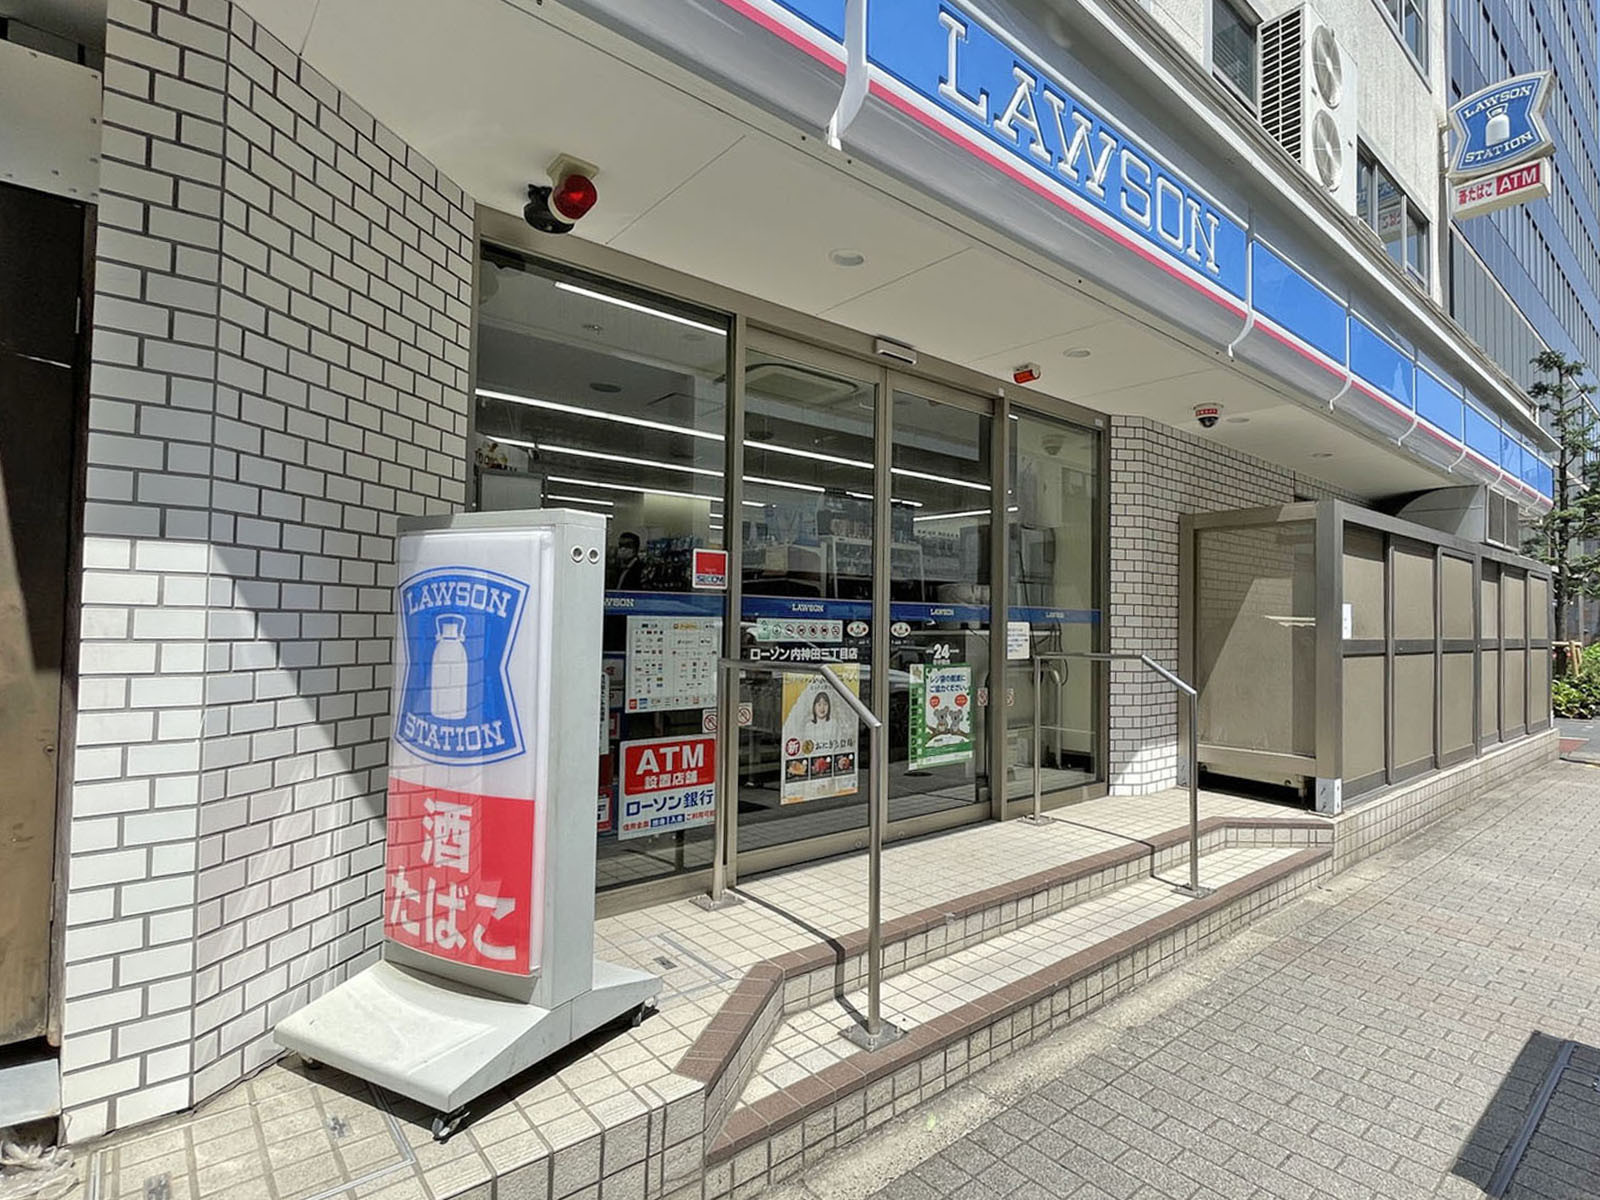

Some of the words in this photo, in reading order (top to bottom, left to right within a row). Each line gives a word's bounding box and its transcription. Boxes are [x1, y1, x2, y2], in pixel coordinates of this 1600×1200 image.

[1463, 85, 1532, 119] LAWSON
[938, 11, 1220, 275] LAWSON
[1465, 131, 1534, 163] STATION
[1500, 167, 1538, 192] ATM
[696, 575, 726, 584] SECOM
[406, 581, 512, 618] LAWSON
[792, 603, 825, 613] LAWSON
[932, 643, 951, 660] 24
[404, 711, 506, 753] STATION
[636, 743, 704, 775] ATM
[626, 789, 714, 817] ローソン銀行
[420, 799, 473, 874] 酒
[390, 865, 517, 962] たばこ
